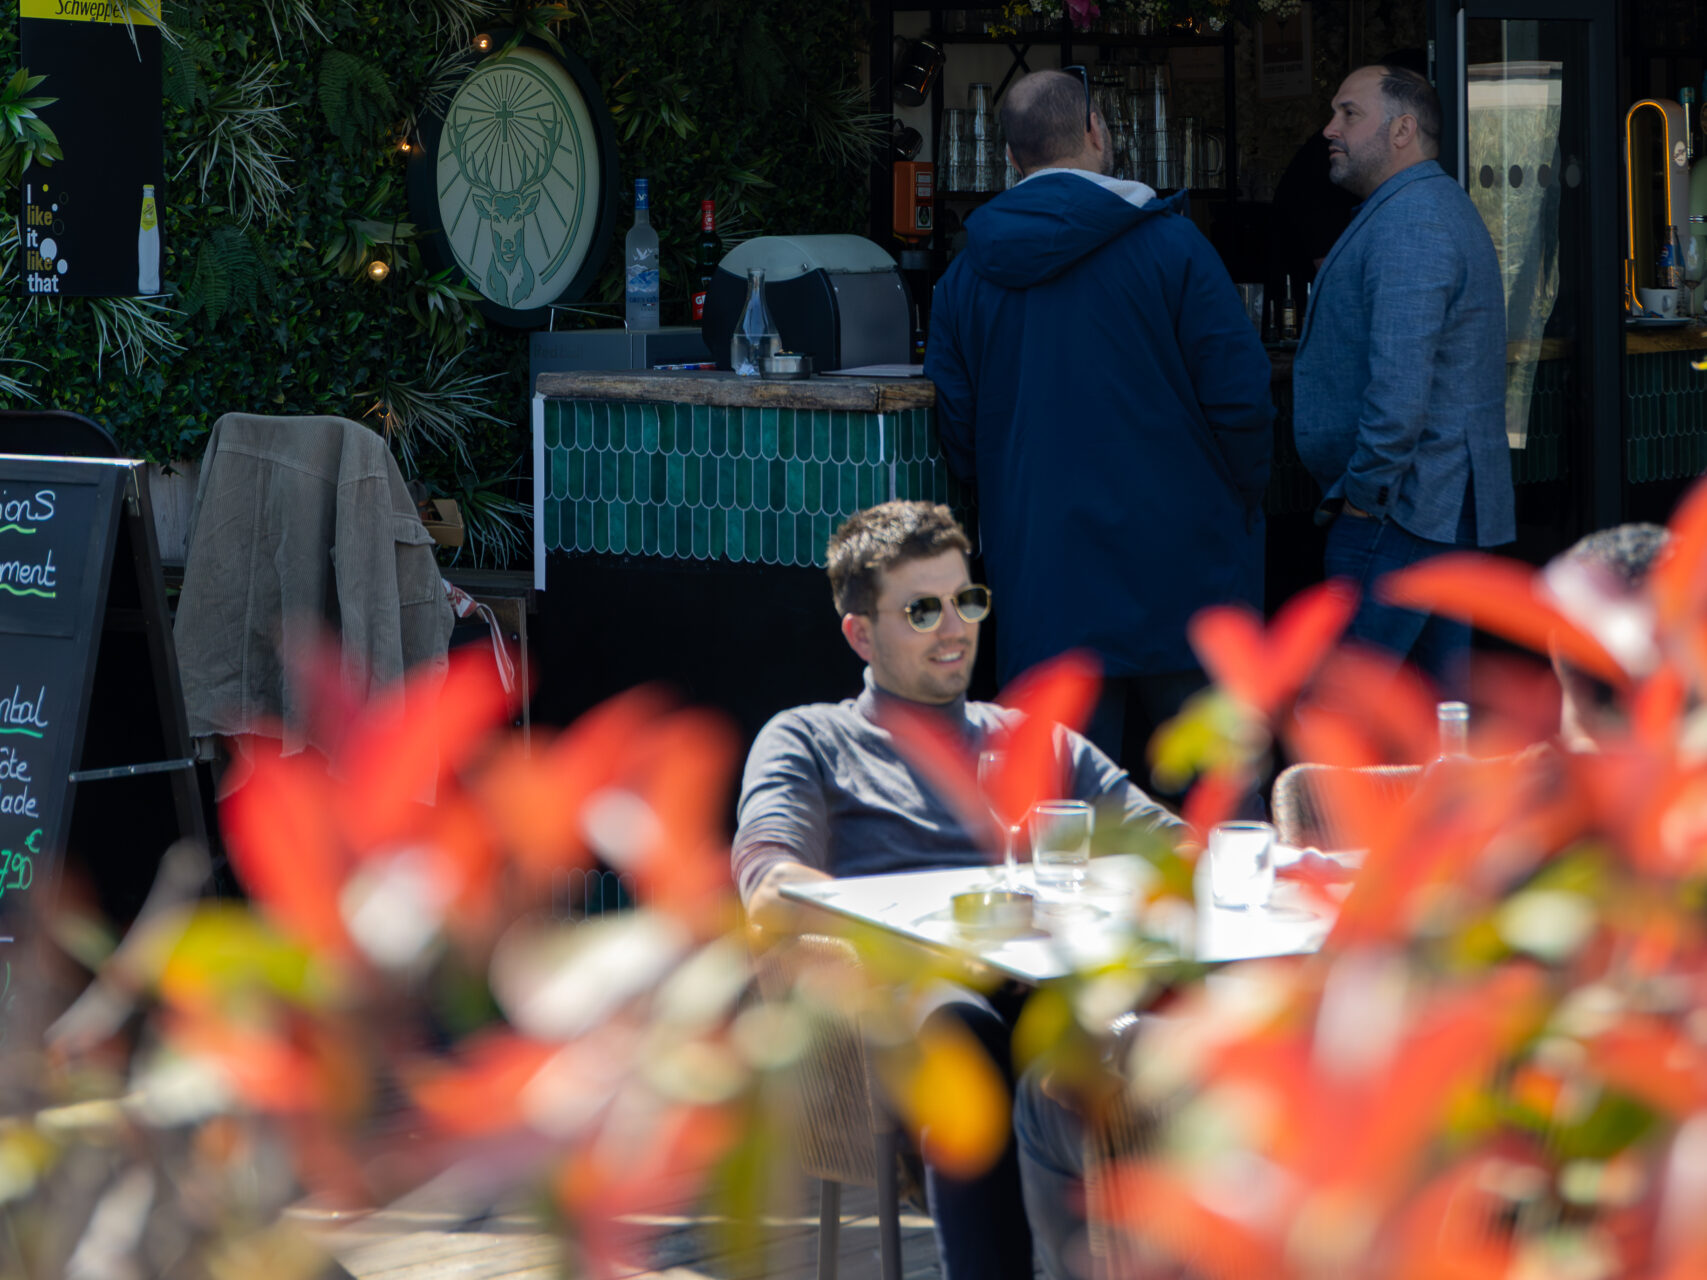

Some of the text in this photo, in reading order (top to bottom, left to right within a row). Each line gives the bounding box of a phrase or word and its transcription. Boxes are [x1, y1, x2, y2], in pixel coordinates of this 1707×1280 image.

[26, 183, 32, 205] I
[26, 204, 54, 227] like
[26, 227, 39, 249] it
[26, 249, 54, 272] like
[26, 271, 60, 294] that
[0, 786, 40, 819] ade
